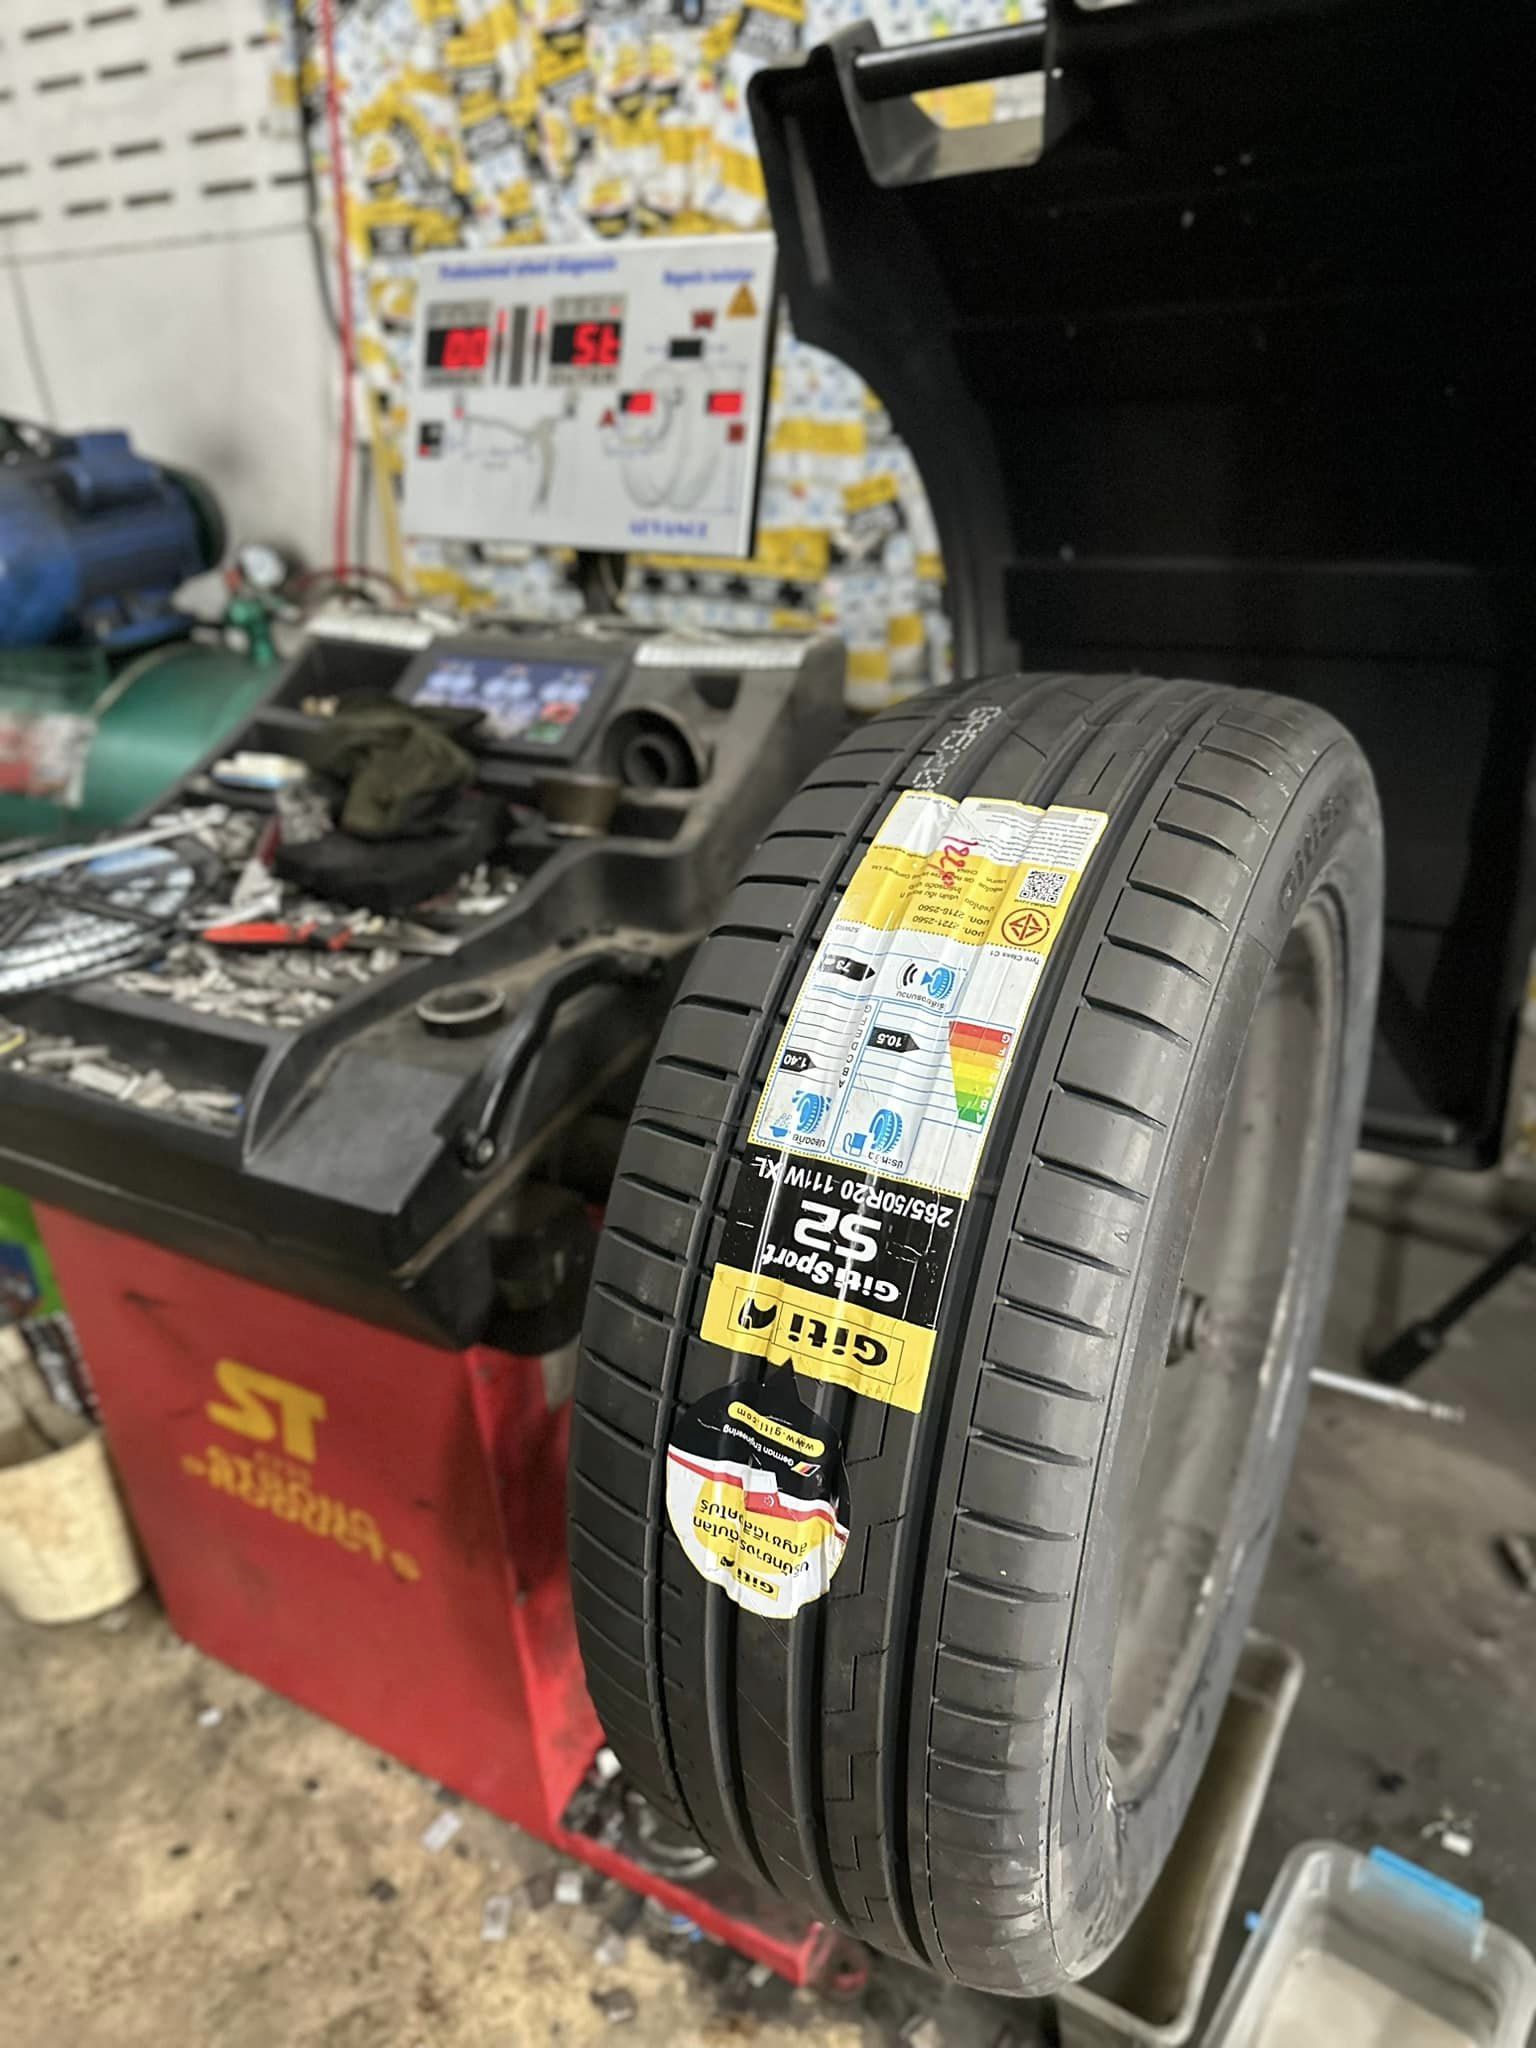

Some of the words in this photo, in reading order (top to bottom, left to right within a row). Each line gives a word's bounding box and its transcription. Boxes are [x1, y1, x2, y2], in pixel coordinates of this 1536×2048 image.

[876, 1032, 904, 1049] 10.5
[783, 1053, 808, 1067] 1.40
[754, 1156, 781, 1180] XL
[783, 1165, 834, 1192] 111W
[840, 1179, 954, 1228] 265/50R20
[793, 1199, 882, 1263] S2
[788, 1313, 888, 1367] Giti
[206, 1358, 327, 1463] ST
[722, 1423, 762, 1452] Engineering
[735, 1407, 815, 1452] www.giti.com
[762, 1446, 795, 1467] German
[692, 1516, 810, 1578] บริษัทยางรดับโลก
[736, 1569, 774, 1595] Giti
